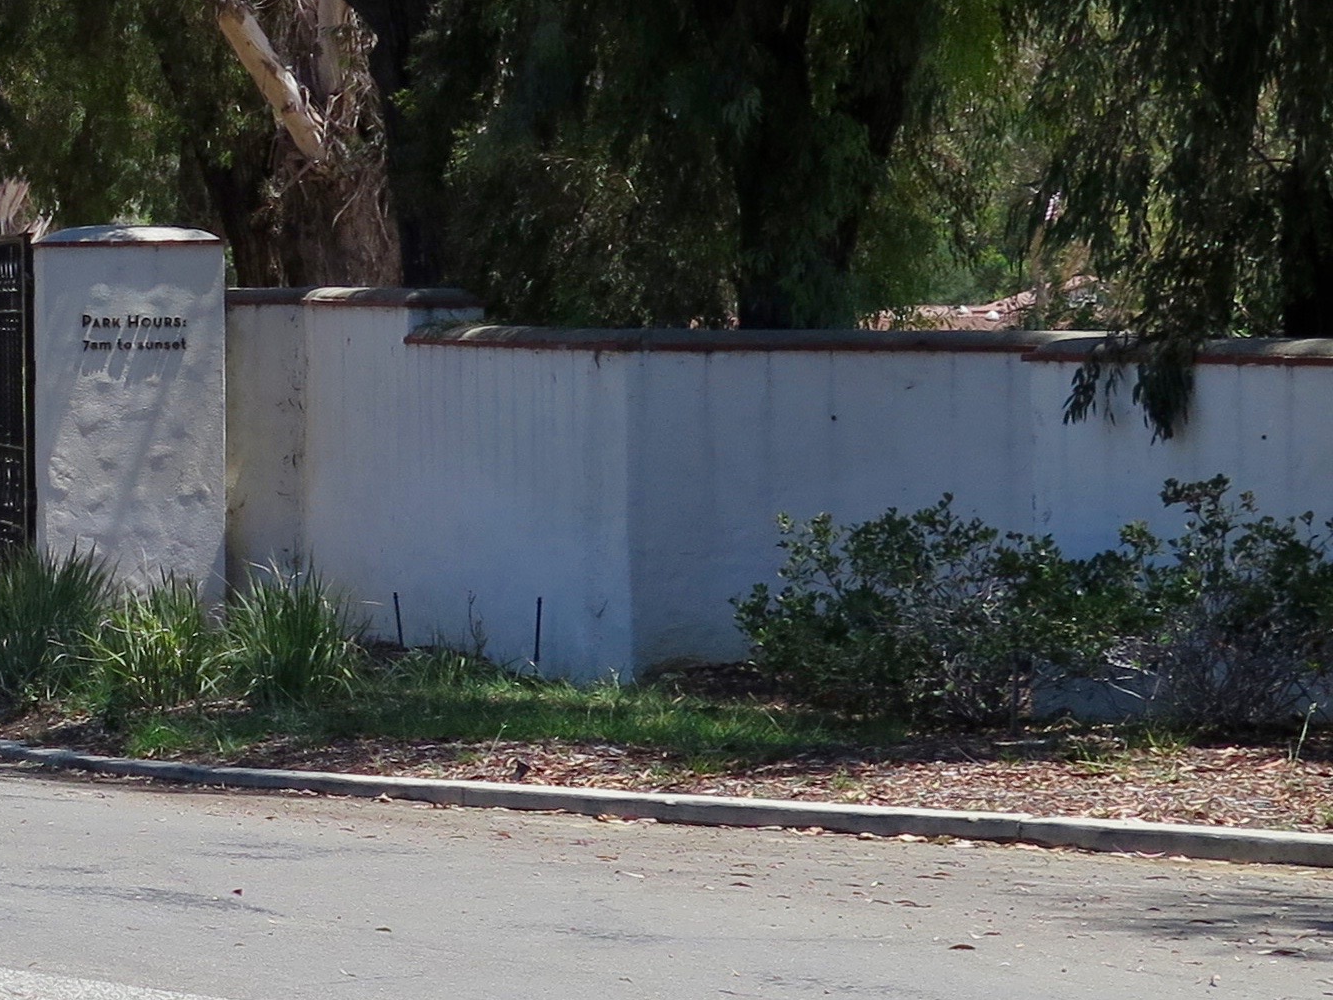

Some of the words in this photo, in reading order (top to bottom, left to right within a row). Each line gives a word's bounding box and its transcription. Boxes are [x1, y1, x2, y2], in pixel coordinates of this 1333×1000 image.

[81, 314, 121, 328] PARK
[127, 314, 187, 328] HOURS:
[82, 339, 112, 352] 7am
[117, 338, 132, 351] to
[137, 337, 187, 351] sunset
